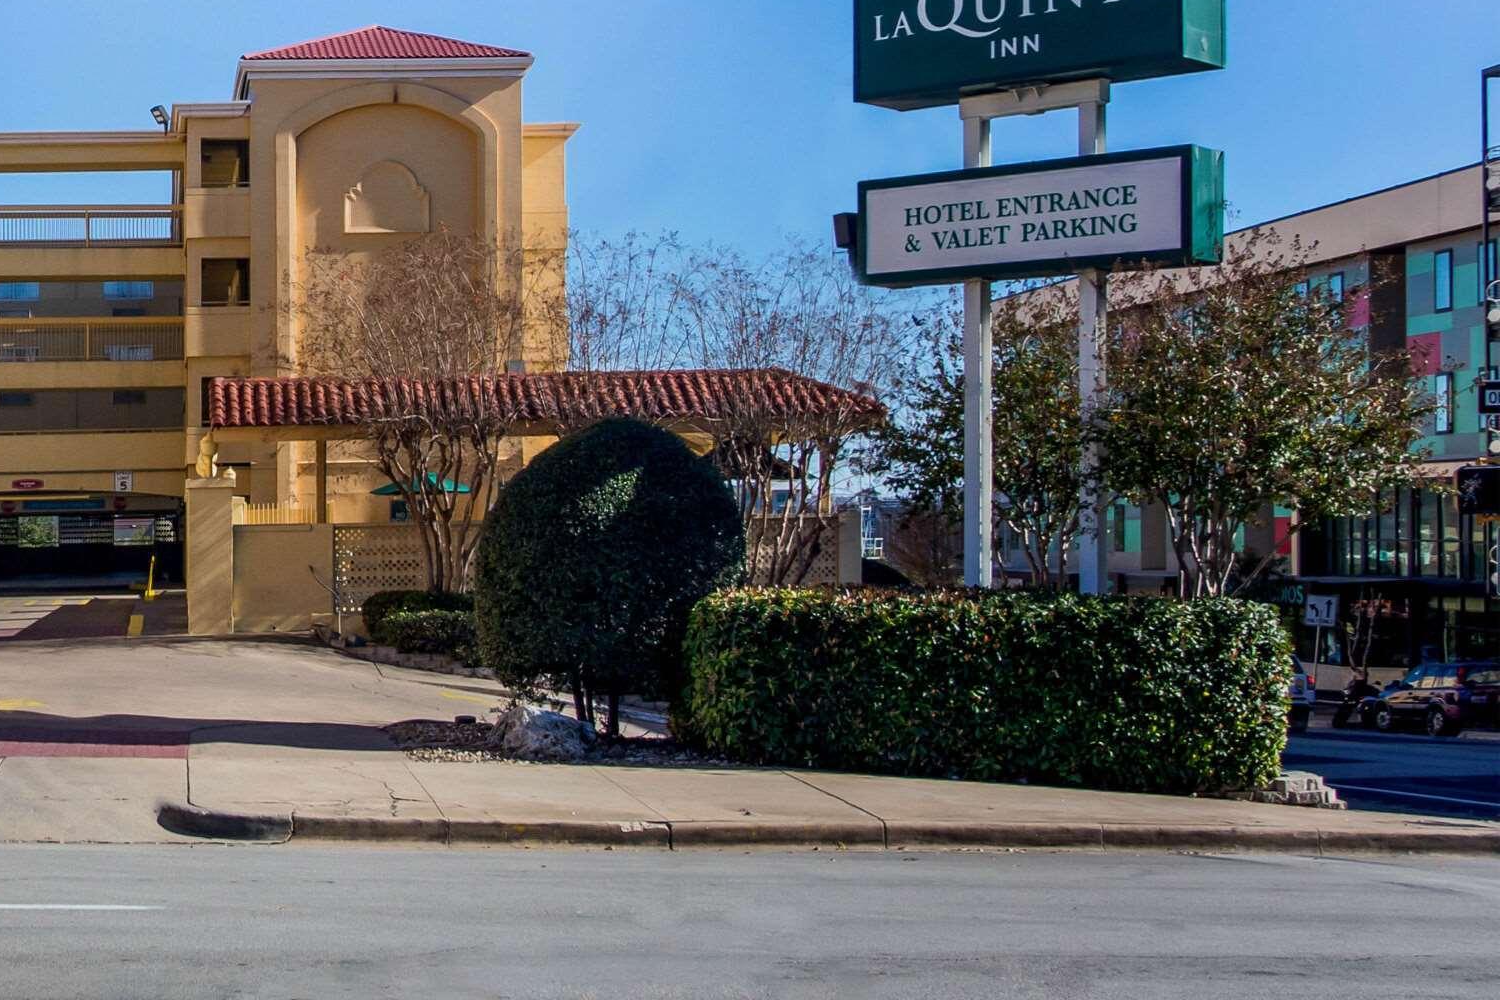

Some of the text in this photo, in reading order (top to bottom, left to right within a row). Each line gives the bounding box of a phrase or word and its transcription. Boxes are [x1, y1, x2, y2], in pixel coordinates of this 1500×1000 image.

[874, 11, 914, 40] LA
[990, 33, 1040, 59] INN
[904, 184, 1137, 226] HOTEL ENTRANCE
[904, 213, 1137, 252] & VALET PARKING
[120, 481, 128, 490] 5
